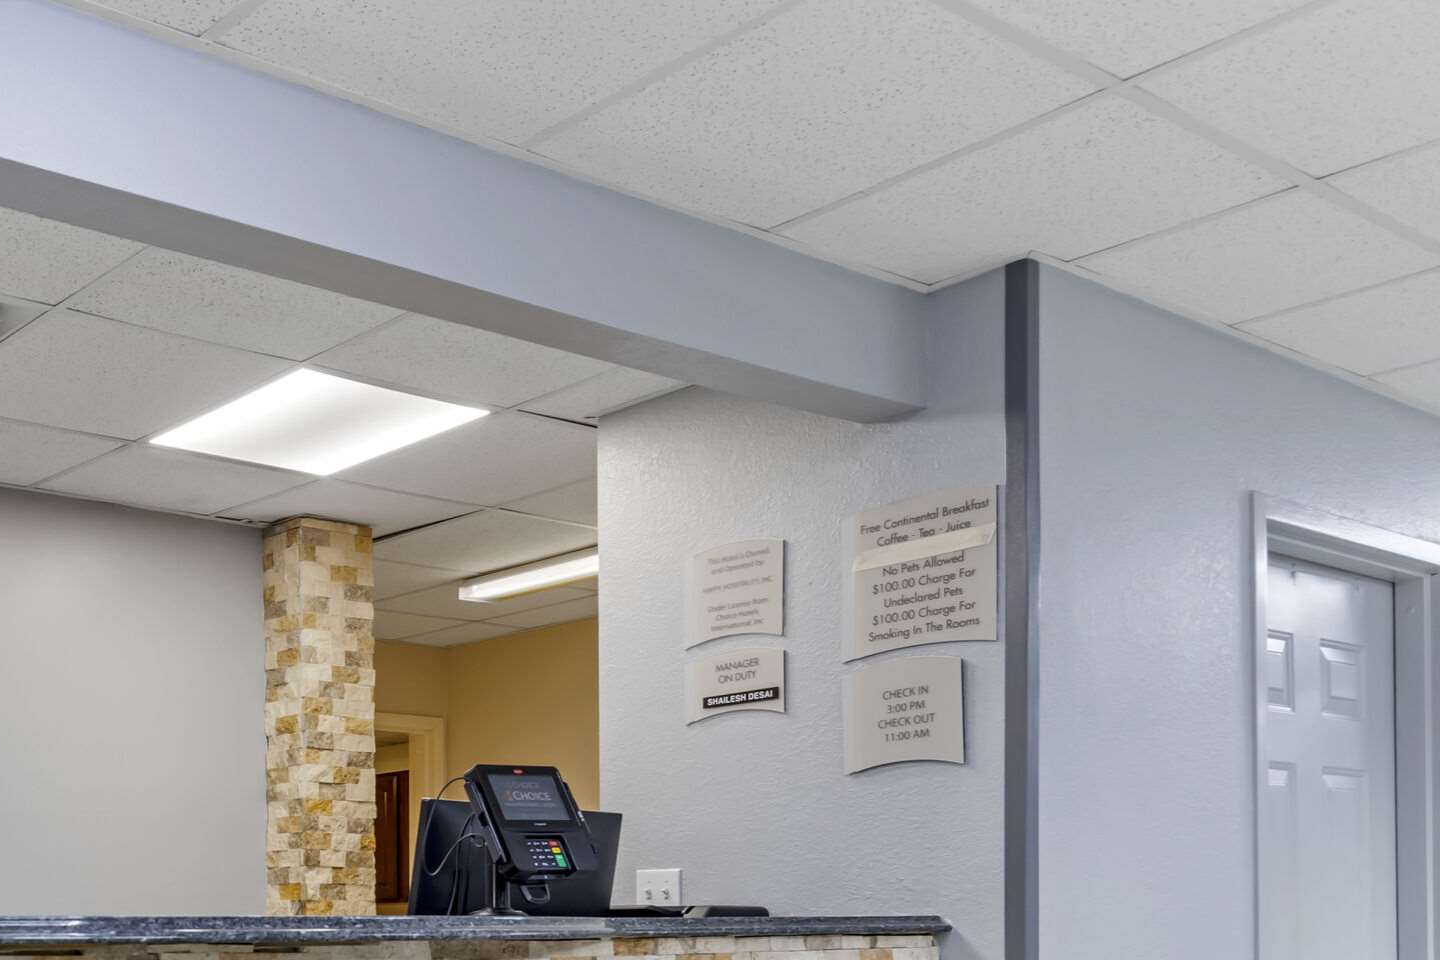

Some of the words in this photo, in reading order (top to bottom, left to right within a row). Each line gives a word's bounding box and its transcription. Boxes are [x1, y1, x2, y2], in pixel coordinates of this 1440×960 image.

[860, 525, 881, 535] Free
[883, 508, 939, 530] Continental
[942, 498, 989, 516] Breakfast
[877, 533, 909, 547] Coffee
[919, 528, 935, 538] Tea
[945, 520, 971, 533] Juice
[882, 566, 898, 577] No
[901, 563, 920, 573] Pets
[923, 550, 965, 568] Allowed
[872, 577, 915, 595] $100.00
[918, 572, 956, 585] Charge
[959, 568, 976, 578] For
[883, 588, 940, 608] Undeclared
[943, 587, 963, 597] Pets
[872, 609, 915, 626] $100.00
[918, 606, 956, 617] Charge
[959, 600, 976, 611] For
[868, 628, 910, 642] Smoking
[913, 625, 922, 635] In
[925, 621, 943, 633] The
[946, 618, 980, 629] Rooms
[715, 657, 760, 672] MANAGER
[718, 674, 733, 684] ON
[735, 670, 756, 681] DUTY
[707, 693, 746, 706] SHAILESH
[748, 690, 773, 700] DESAI
[882, 687, 916, 700] CHECK
[918, 685, 929, 695] IN
[887, 702, 907, 714] 3:00
[909, 700, 926, 710] PM
[878, 717, 911, 729] CHECK
[913, 712, 935, 724] OUT
[885, 731, 911, 742] 11:00
[913, 728, 930, 738] AM
[512, 790, 552, 801] CHOICE
